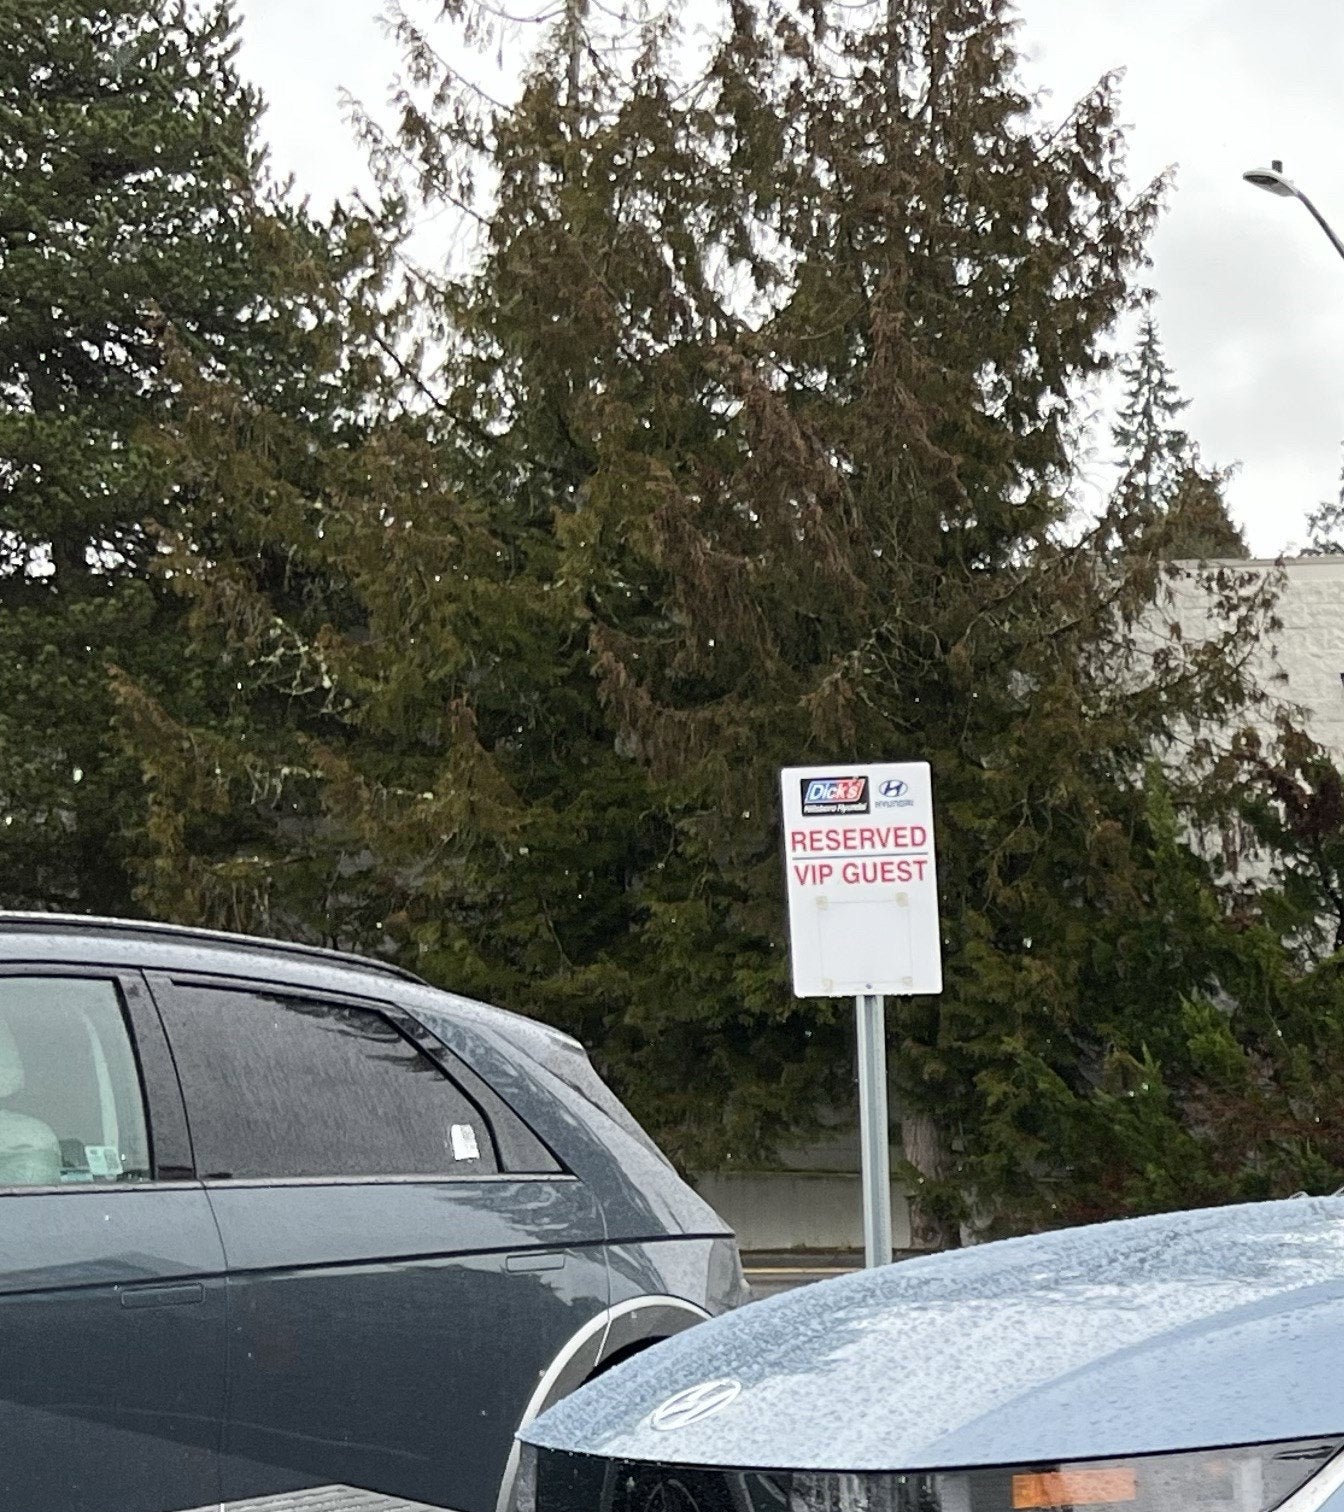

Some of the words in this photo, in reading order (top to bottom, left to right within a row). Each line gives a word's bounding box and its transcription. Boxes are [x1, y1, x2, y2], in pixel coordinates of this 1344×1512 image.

[791, 827, 927, 851] RESERVED
[794, 864, 833, 885] VIP
[842, 860, 928, 884] GUEST
